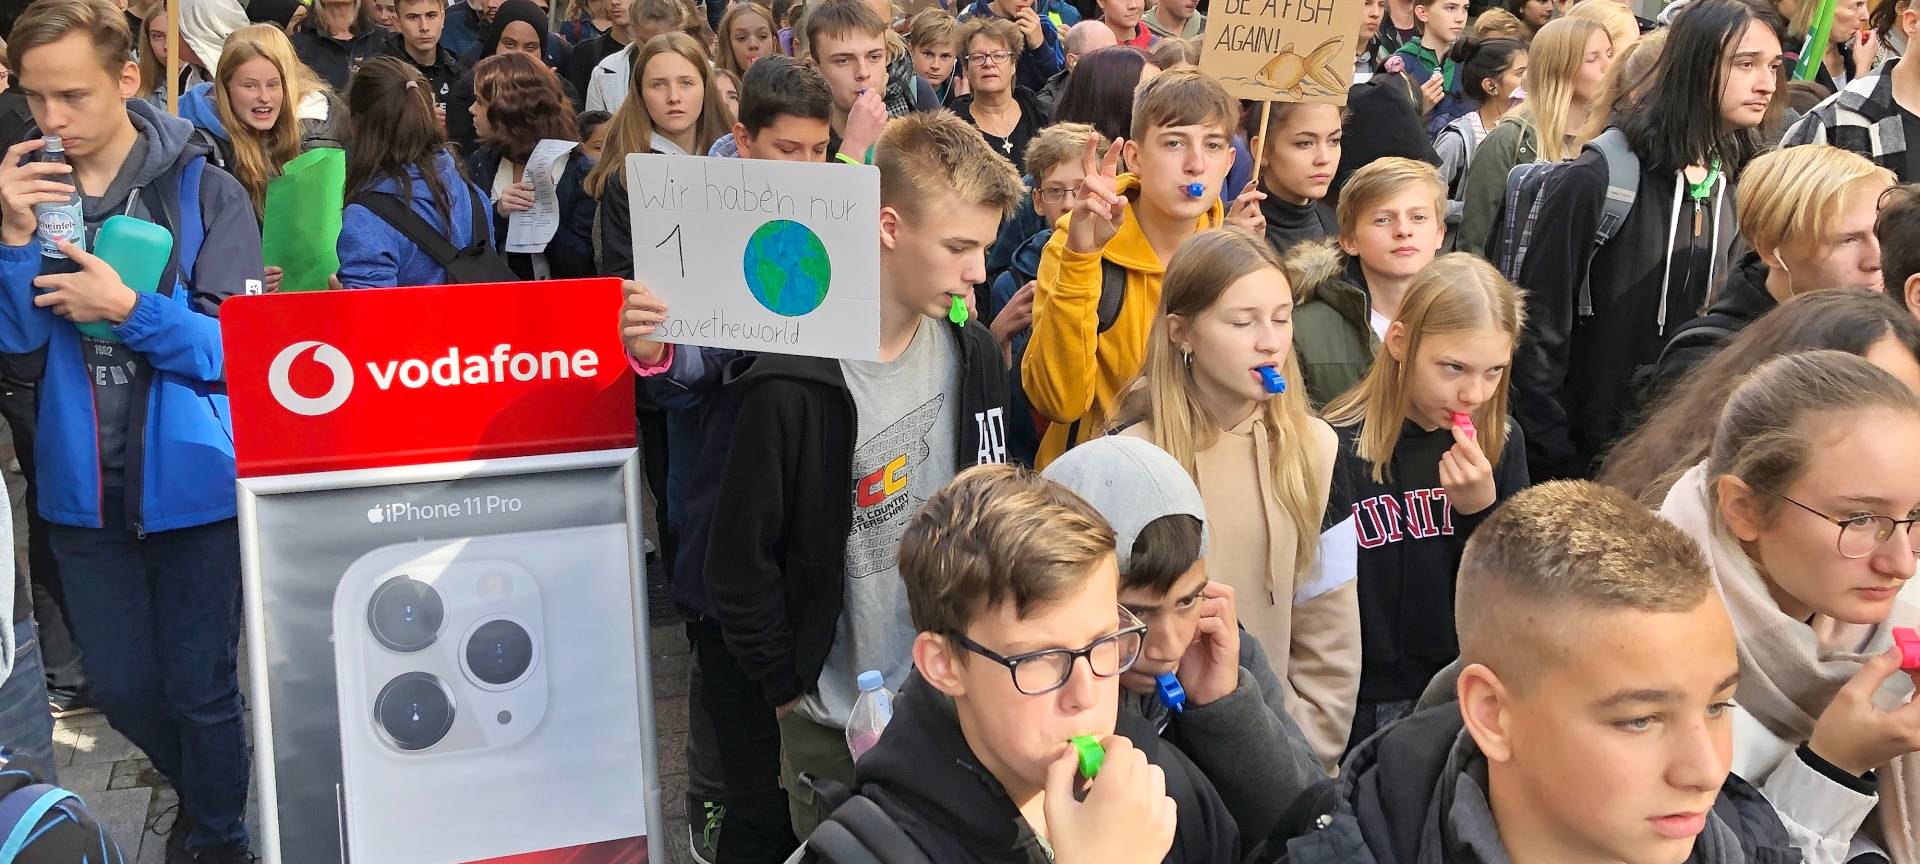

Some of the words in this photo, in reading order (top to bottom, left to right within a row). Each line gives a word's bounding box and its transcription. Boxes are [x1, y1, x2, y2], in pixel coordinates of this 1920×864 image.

[1260, 0, 1277, 18] A
[1282, 0, 1335, 25] FISH
[1214, 23, 1281, 54] AGAIN!
[633, 161, 689, 209] Wir
[703, 161, 795, 216] haben
[810, 194, 857, 222] nur
[655, 223, 685, 279] 1
[640, 308, 800, 345] savetheworld
[366, 343, 599, 390] vodafone
[386, 502, 461, 523] iPhone
[463, 496, 481, 516] 11
[486, 495, 523, 514] Pro
